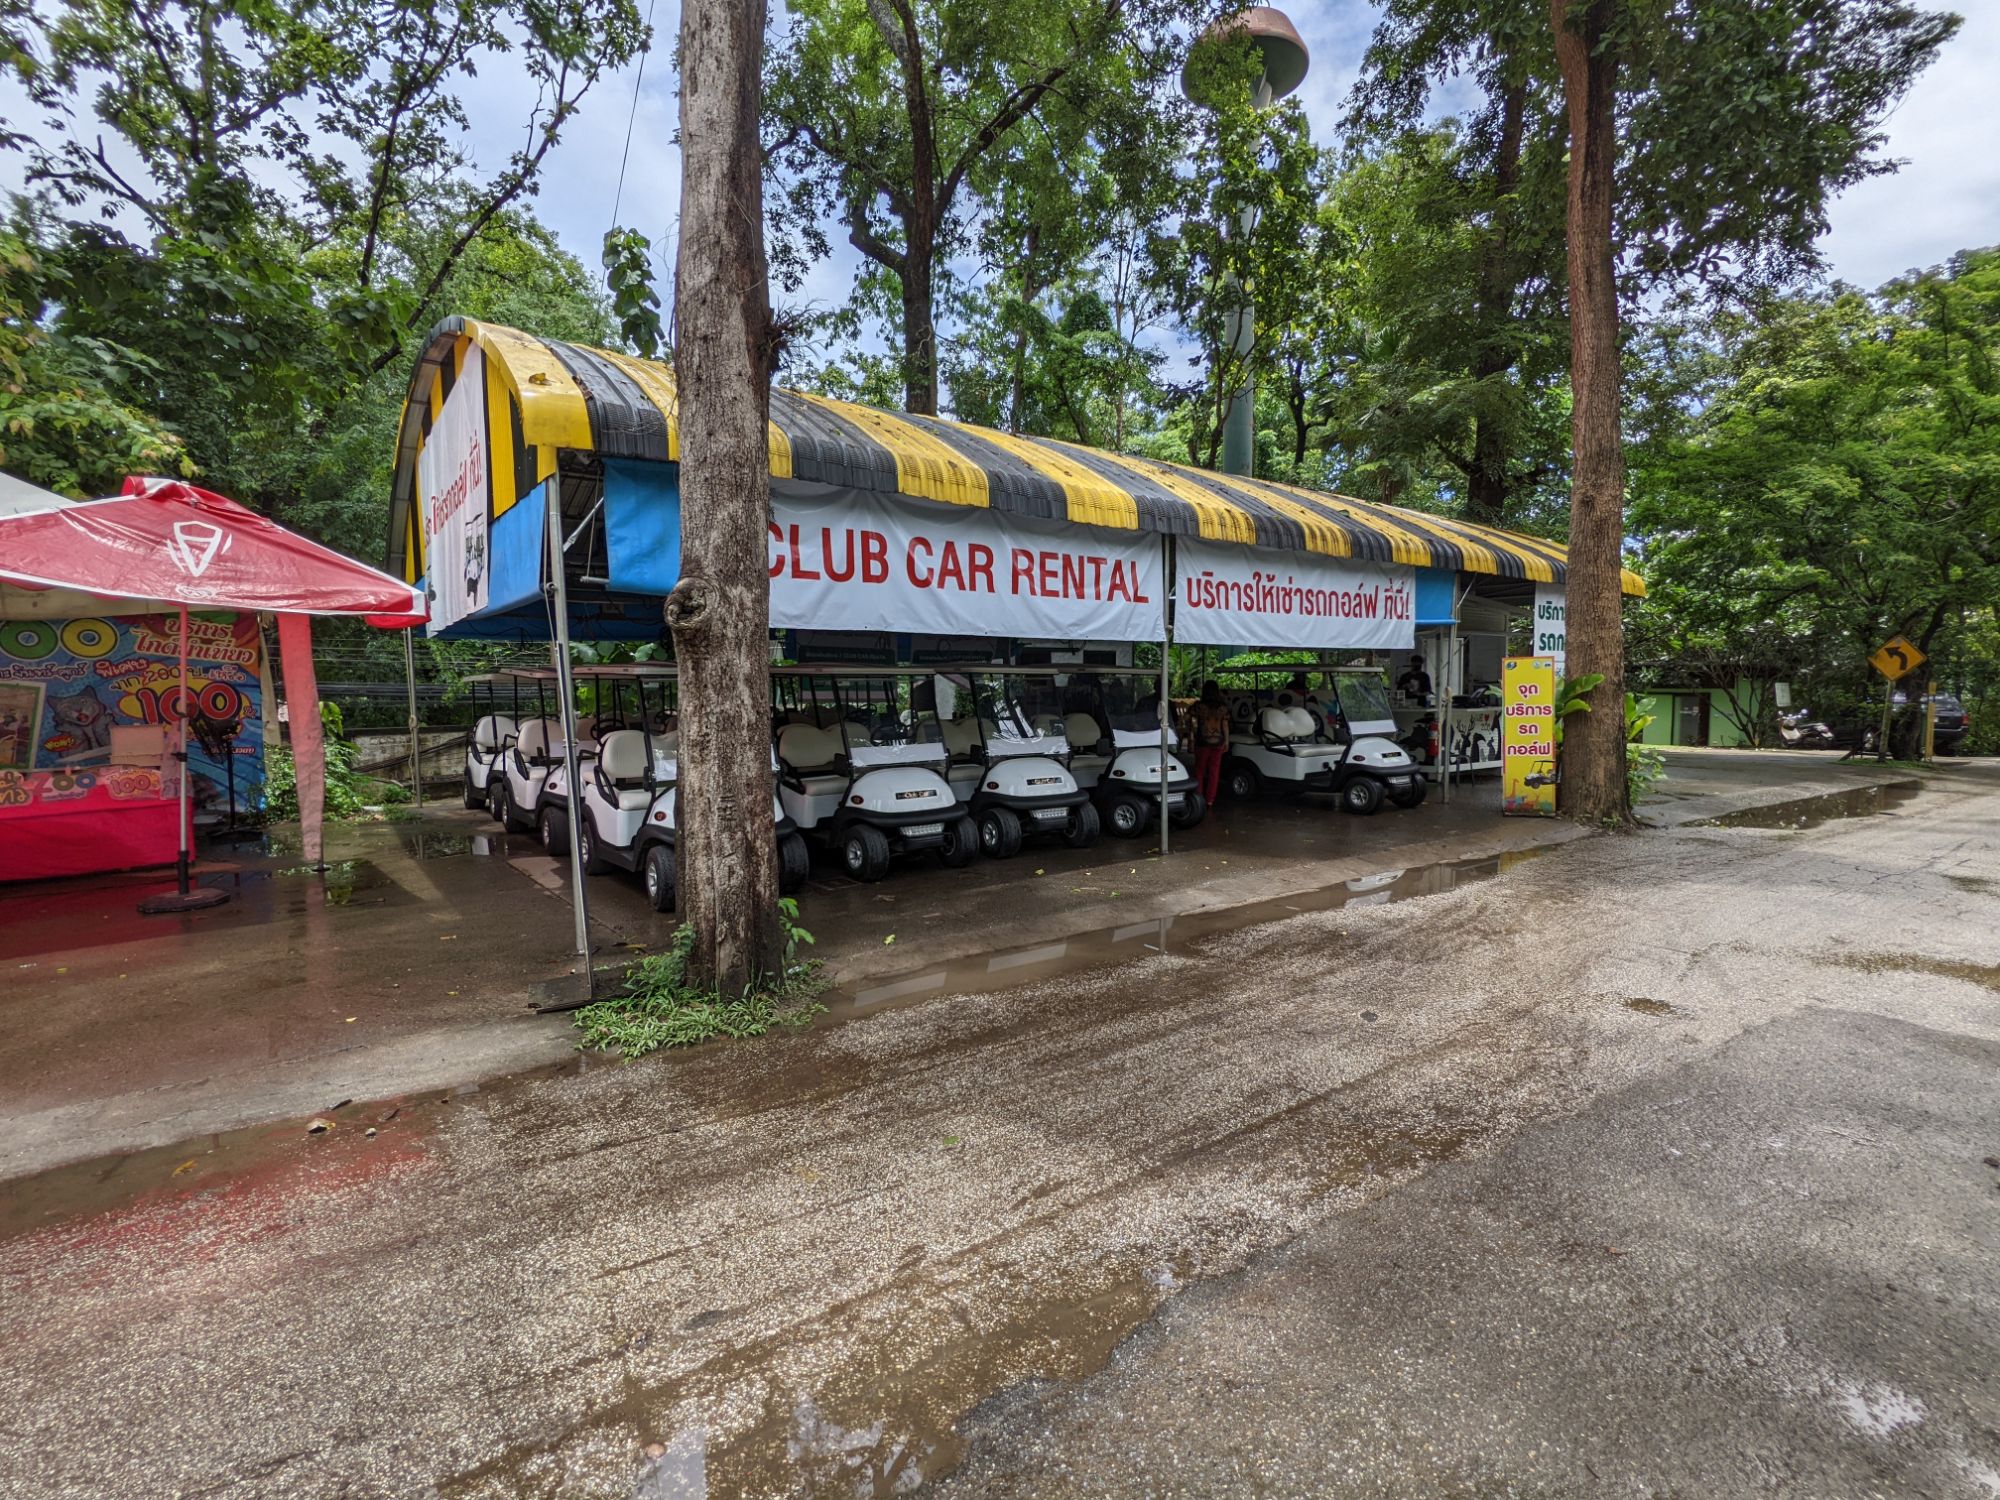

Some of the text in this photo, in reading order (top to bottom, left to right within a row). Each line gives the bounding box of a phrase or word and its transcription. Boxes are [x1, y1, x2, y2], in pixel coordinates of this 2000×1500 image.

[769, 524, 1150, 605] CLUB CAR RENTAL
[1187, 571, 1378, 619] บริการให้เช่ารถกอล์ฟ
[1538, 601, 1565, 621] บริกา
[1538, 632, 1565, 652] รถก
[137, 681, 243, 725] 100
[1505, 703, 1552, 716] บริการ
[1518, 724, 1538, 735] รถ
[1507, 741, 1551, 756] กอล์ฟ
[110, 774, 151, 795] 100
